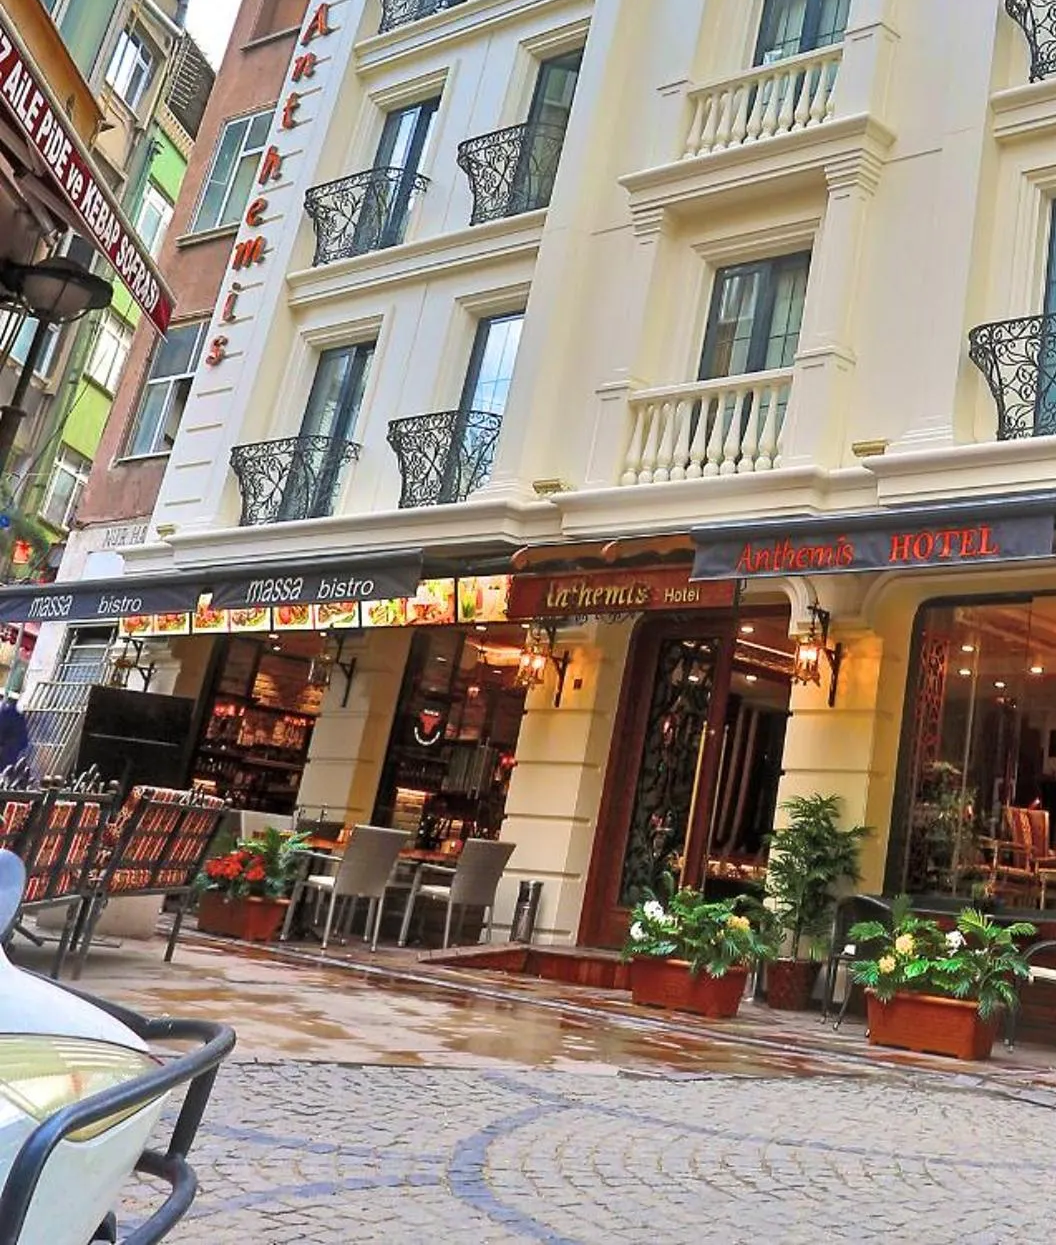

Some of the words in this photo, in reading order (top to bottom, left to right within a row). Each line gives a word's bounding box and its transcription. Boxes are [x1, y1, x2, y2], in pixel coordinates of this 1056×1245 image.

[3, 60, 44, 133] AİLE
[36, 108, 72, 178] PİDE
[66, 163, 84, 200] ve
[80, 179, 121, 252] KEBAP
[205, 3, 329, 367] Anthemis
[735, 534, 854, 574] Anthemis
[888, 523, 999, 562] HOTEL
[27, 594, 74, 618] massa
[97, 595, 143, 614] bistro
[246, 576, 304, 604] massa
[316, 577, 375, 600] bistro
[663, 586, 701, 604] Hotel
